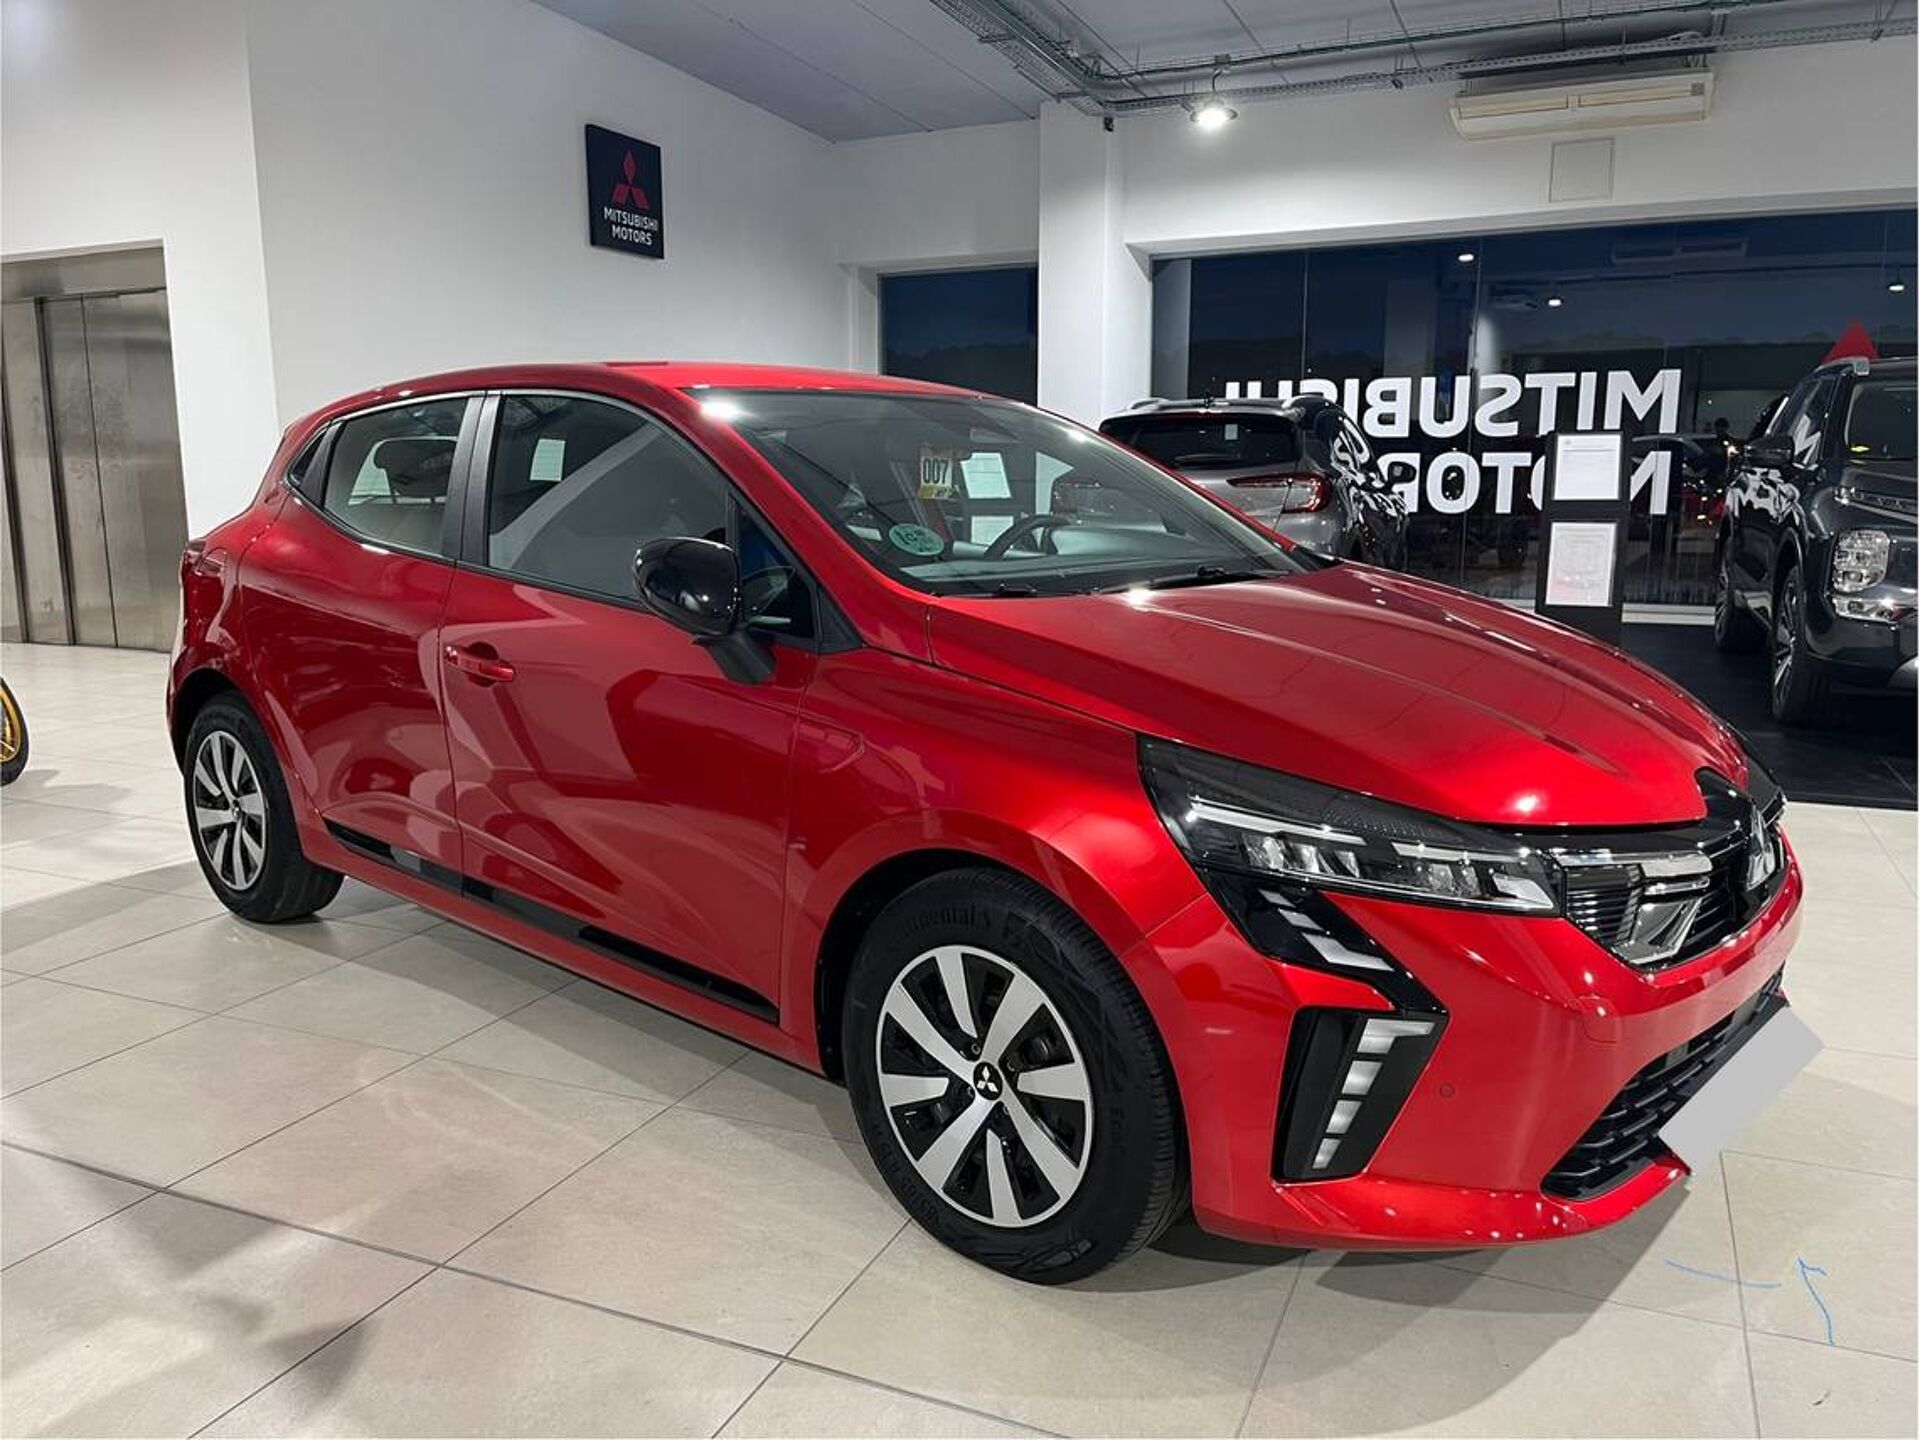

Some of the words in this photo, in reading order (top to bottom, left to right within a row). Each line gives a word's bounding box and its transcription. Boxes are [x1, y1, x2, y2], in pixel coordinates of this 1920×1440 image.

[604, 206, 659, 231] MITSUBISHI
[612, 224, 653, 246] MOTORS
[923, 458, 949, 484] 007
